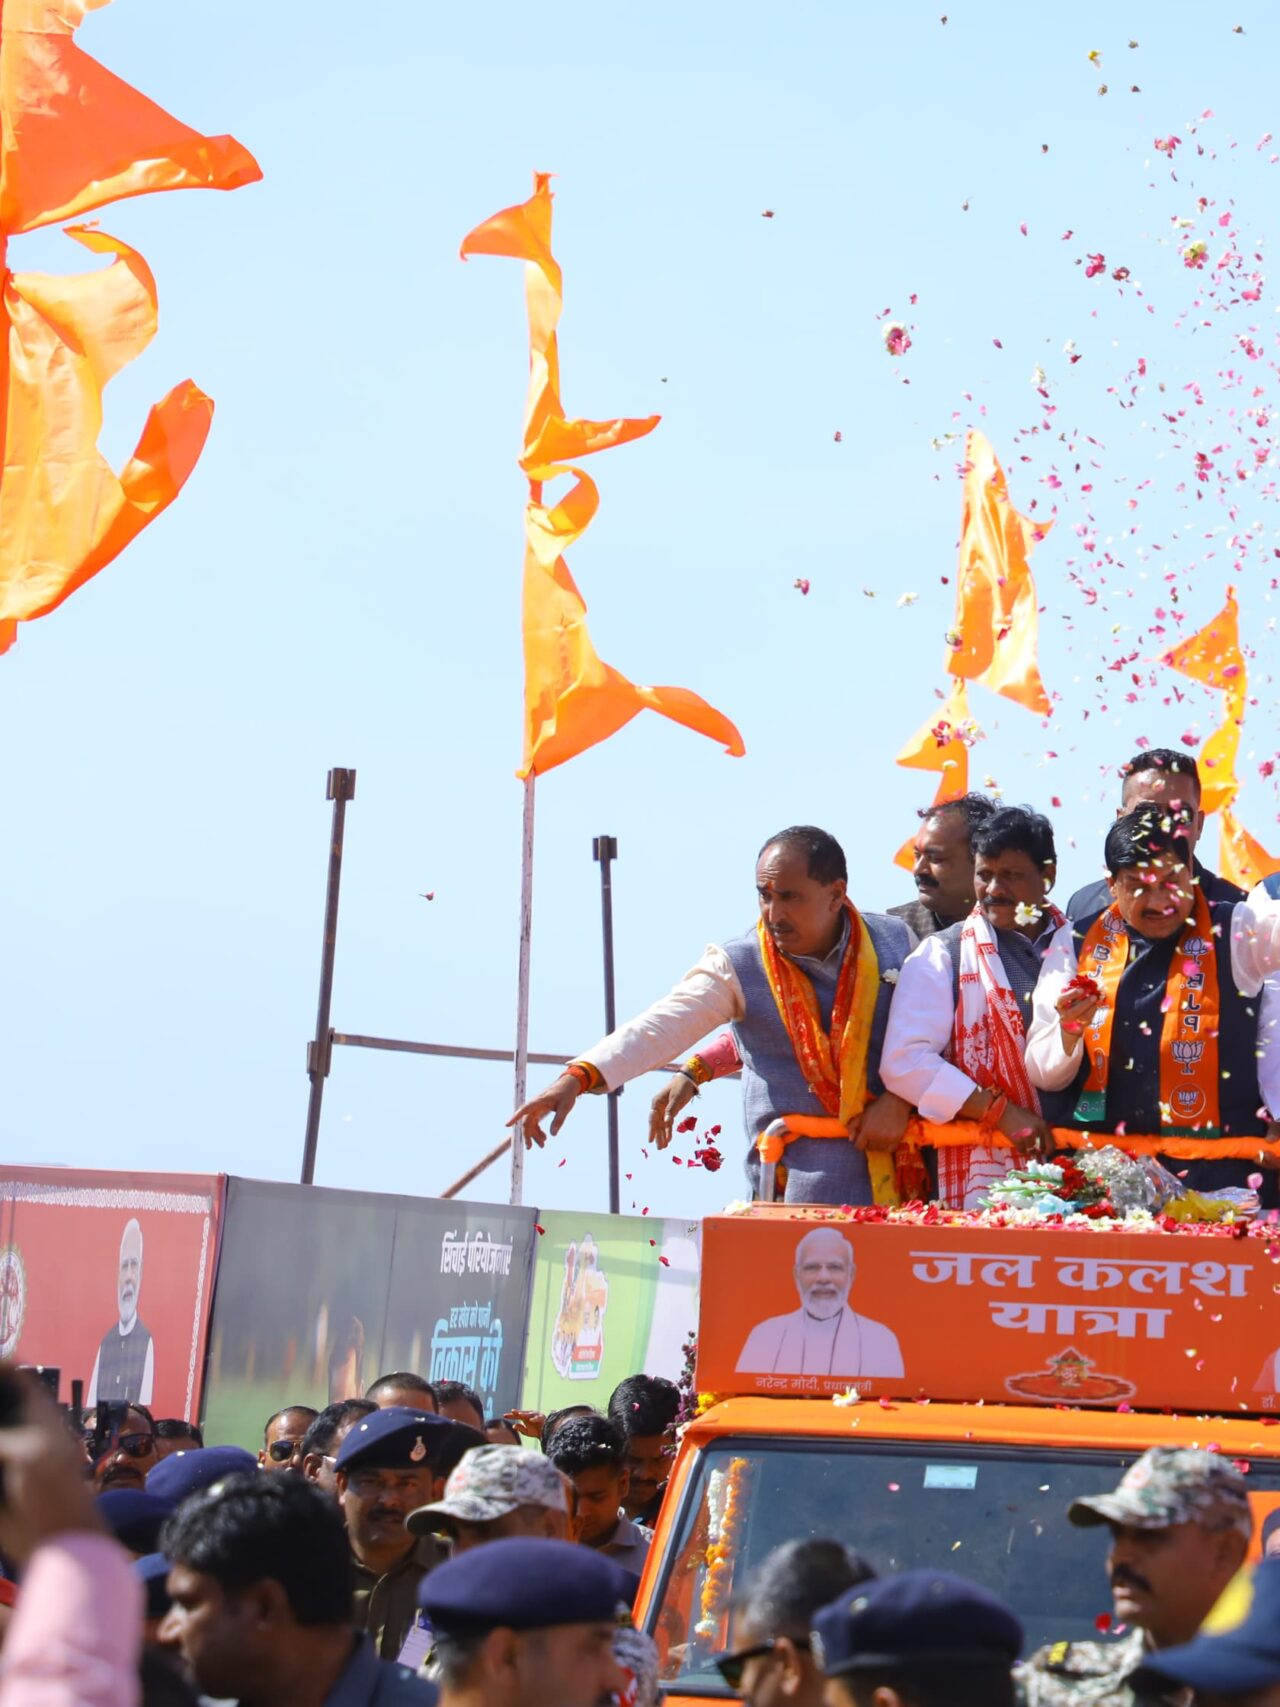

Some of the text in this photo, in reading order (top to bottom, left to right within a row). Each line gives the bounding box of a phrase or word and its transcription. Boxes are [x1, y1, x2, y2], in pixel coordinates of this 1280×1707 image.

[909, 1250, 1254, 1297] जल कलश
[988, 1301, 1173, 1339] यात्रा
[480, 1318, 503, 1392] की
